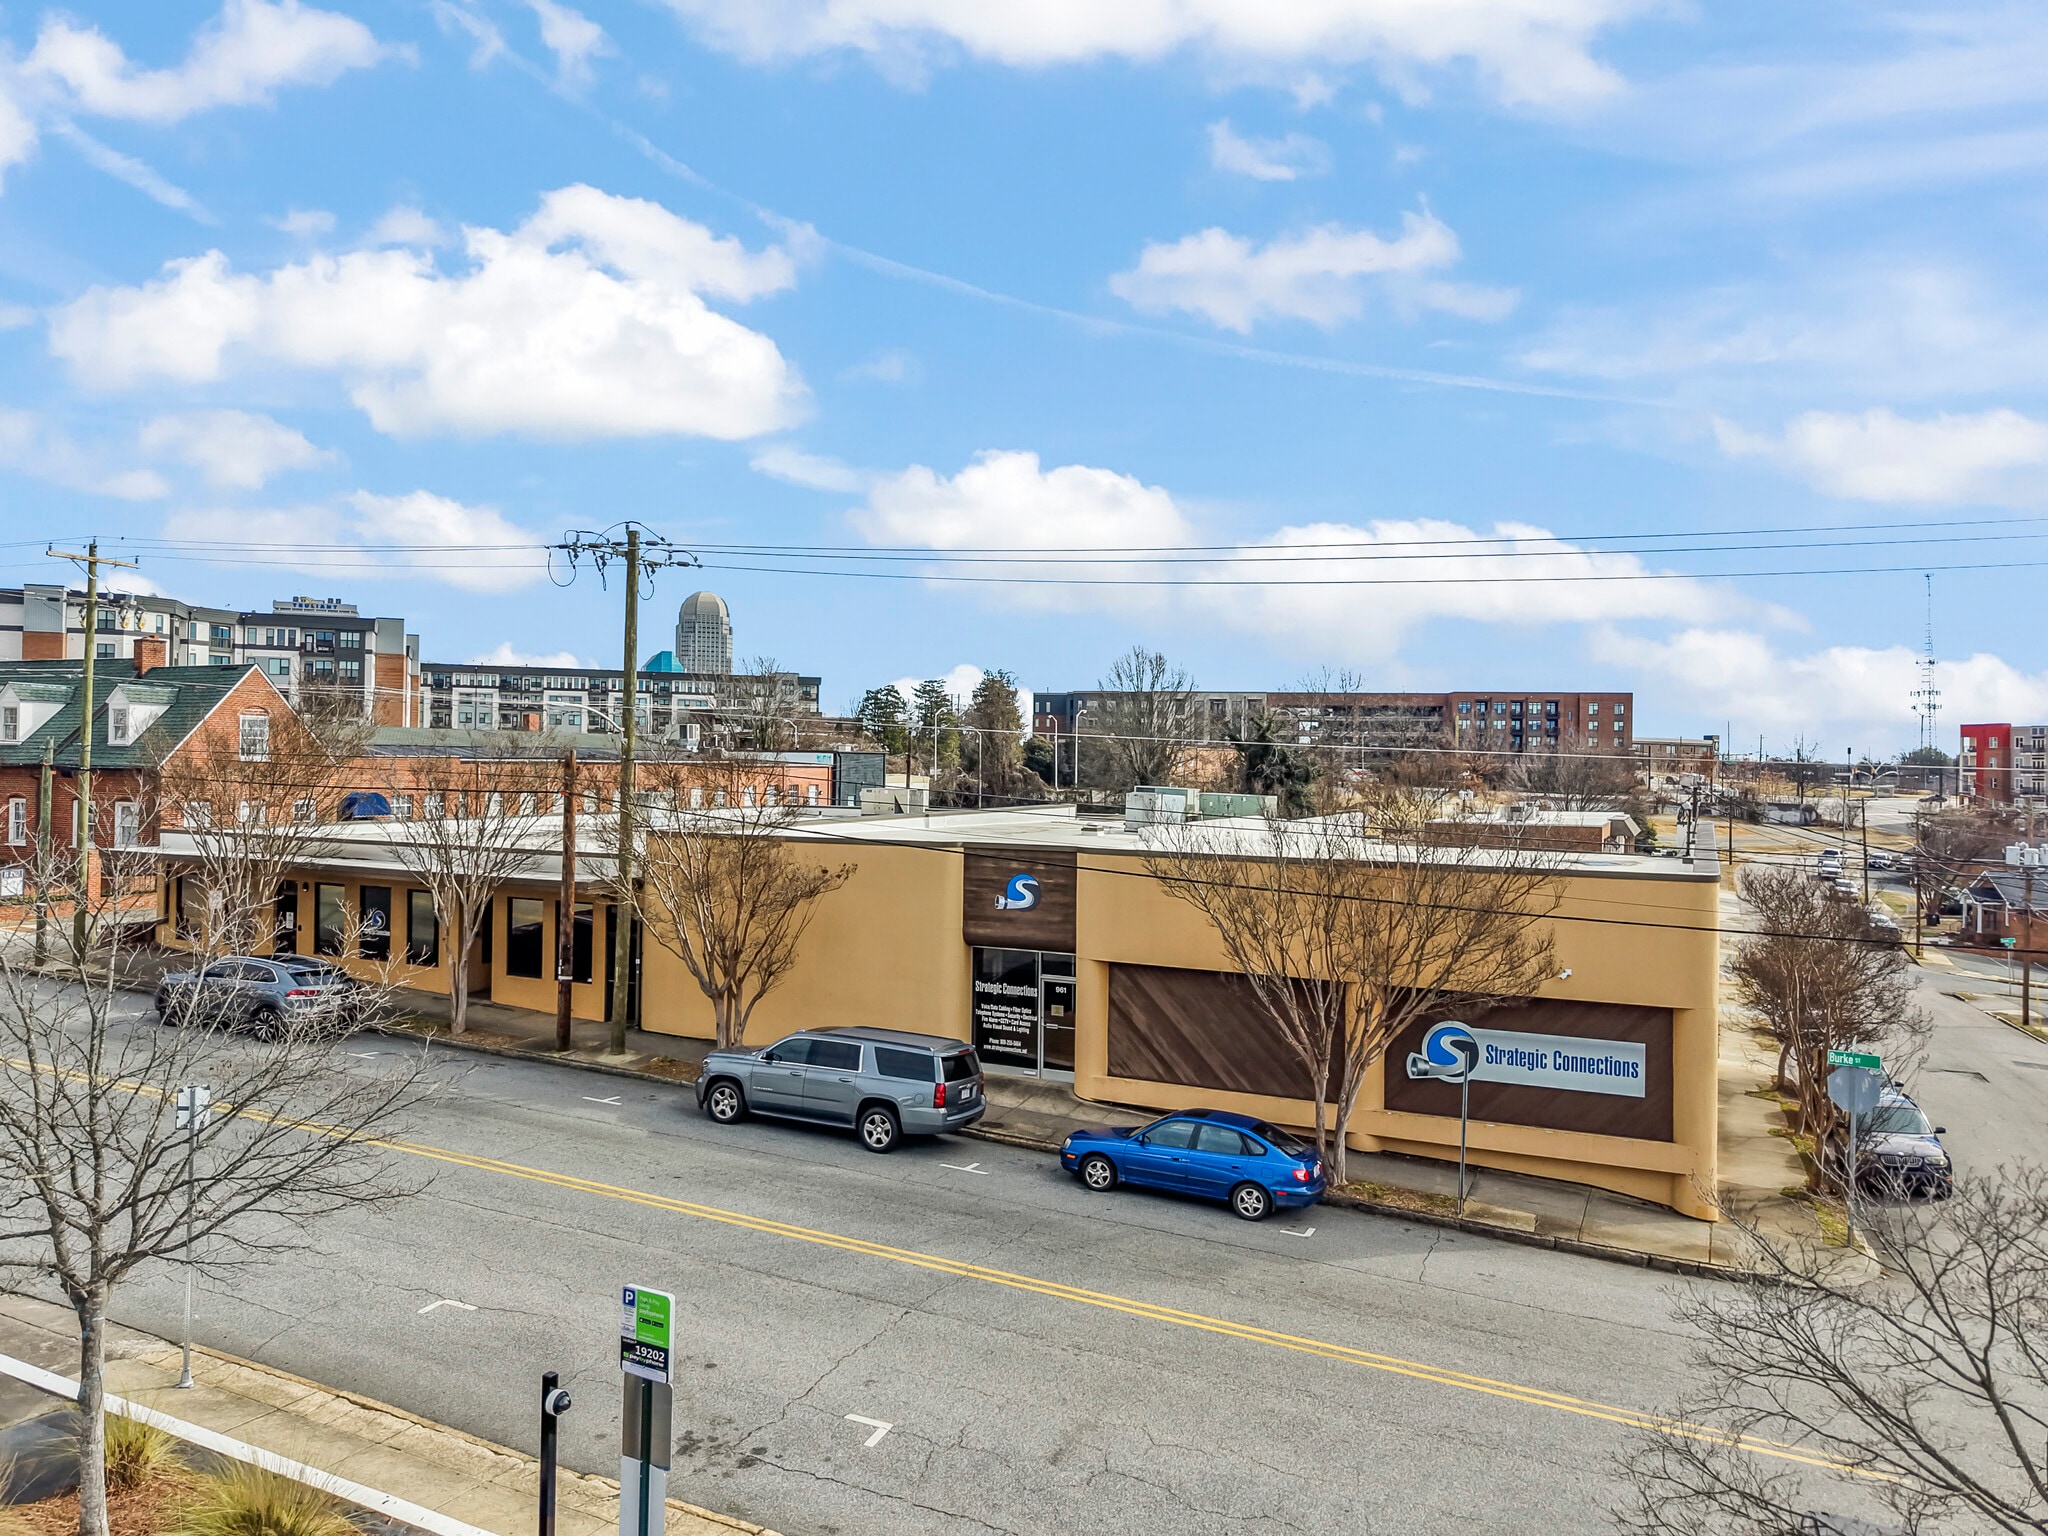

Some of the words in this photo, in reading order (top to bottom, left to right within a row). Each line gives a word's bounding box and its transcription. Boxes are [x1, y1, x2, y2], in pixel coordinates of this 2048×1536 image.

[975, 980, 1002, 995] Strategic
[1003, 983, 1038, 997] Connections
[1486, 1044, 1547, 1071] Strategic
[1553, 1050, 1639, 1079] Connections
[1830, 1052, 1853, 1064] Burke
[625, 1291, 633, 1303] P
[630, 1354, 664, 1367] paybyphone
[635, 1345, 664, 1362] 19202
